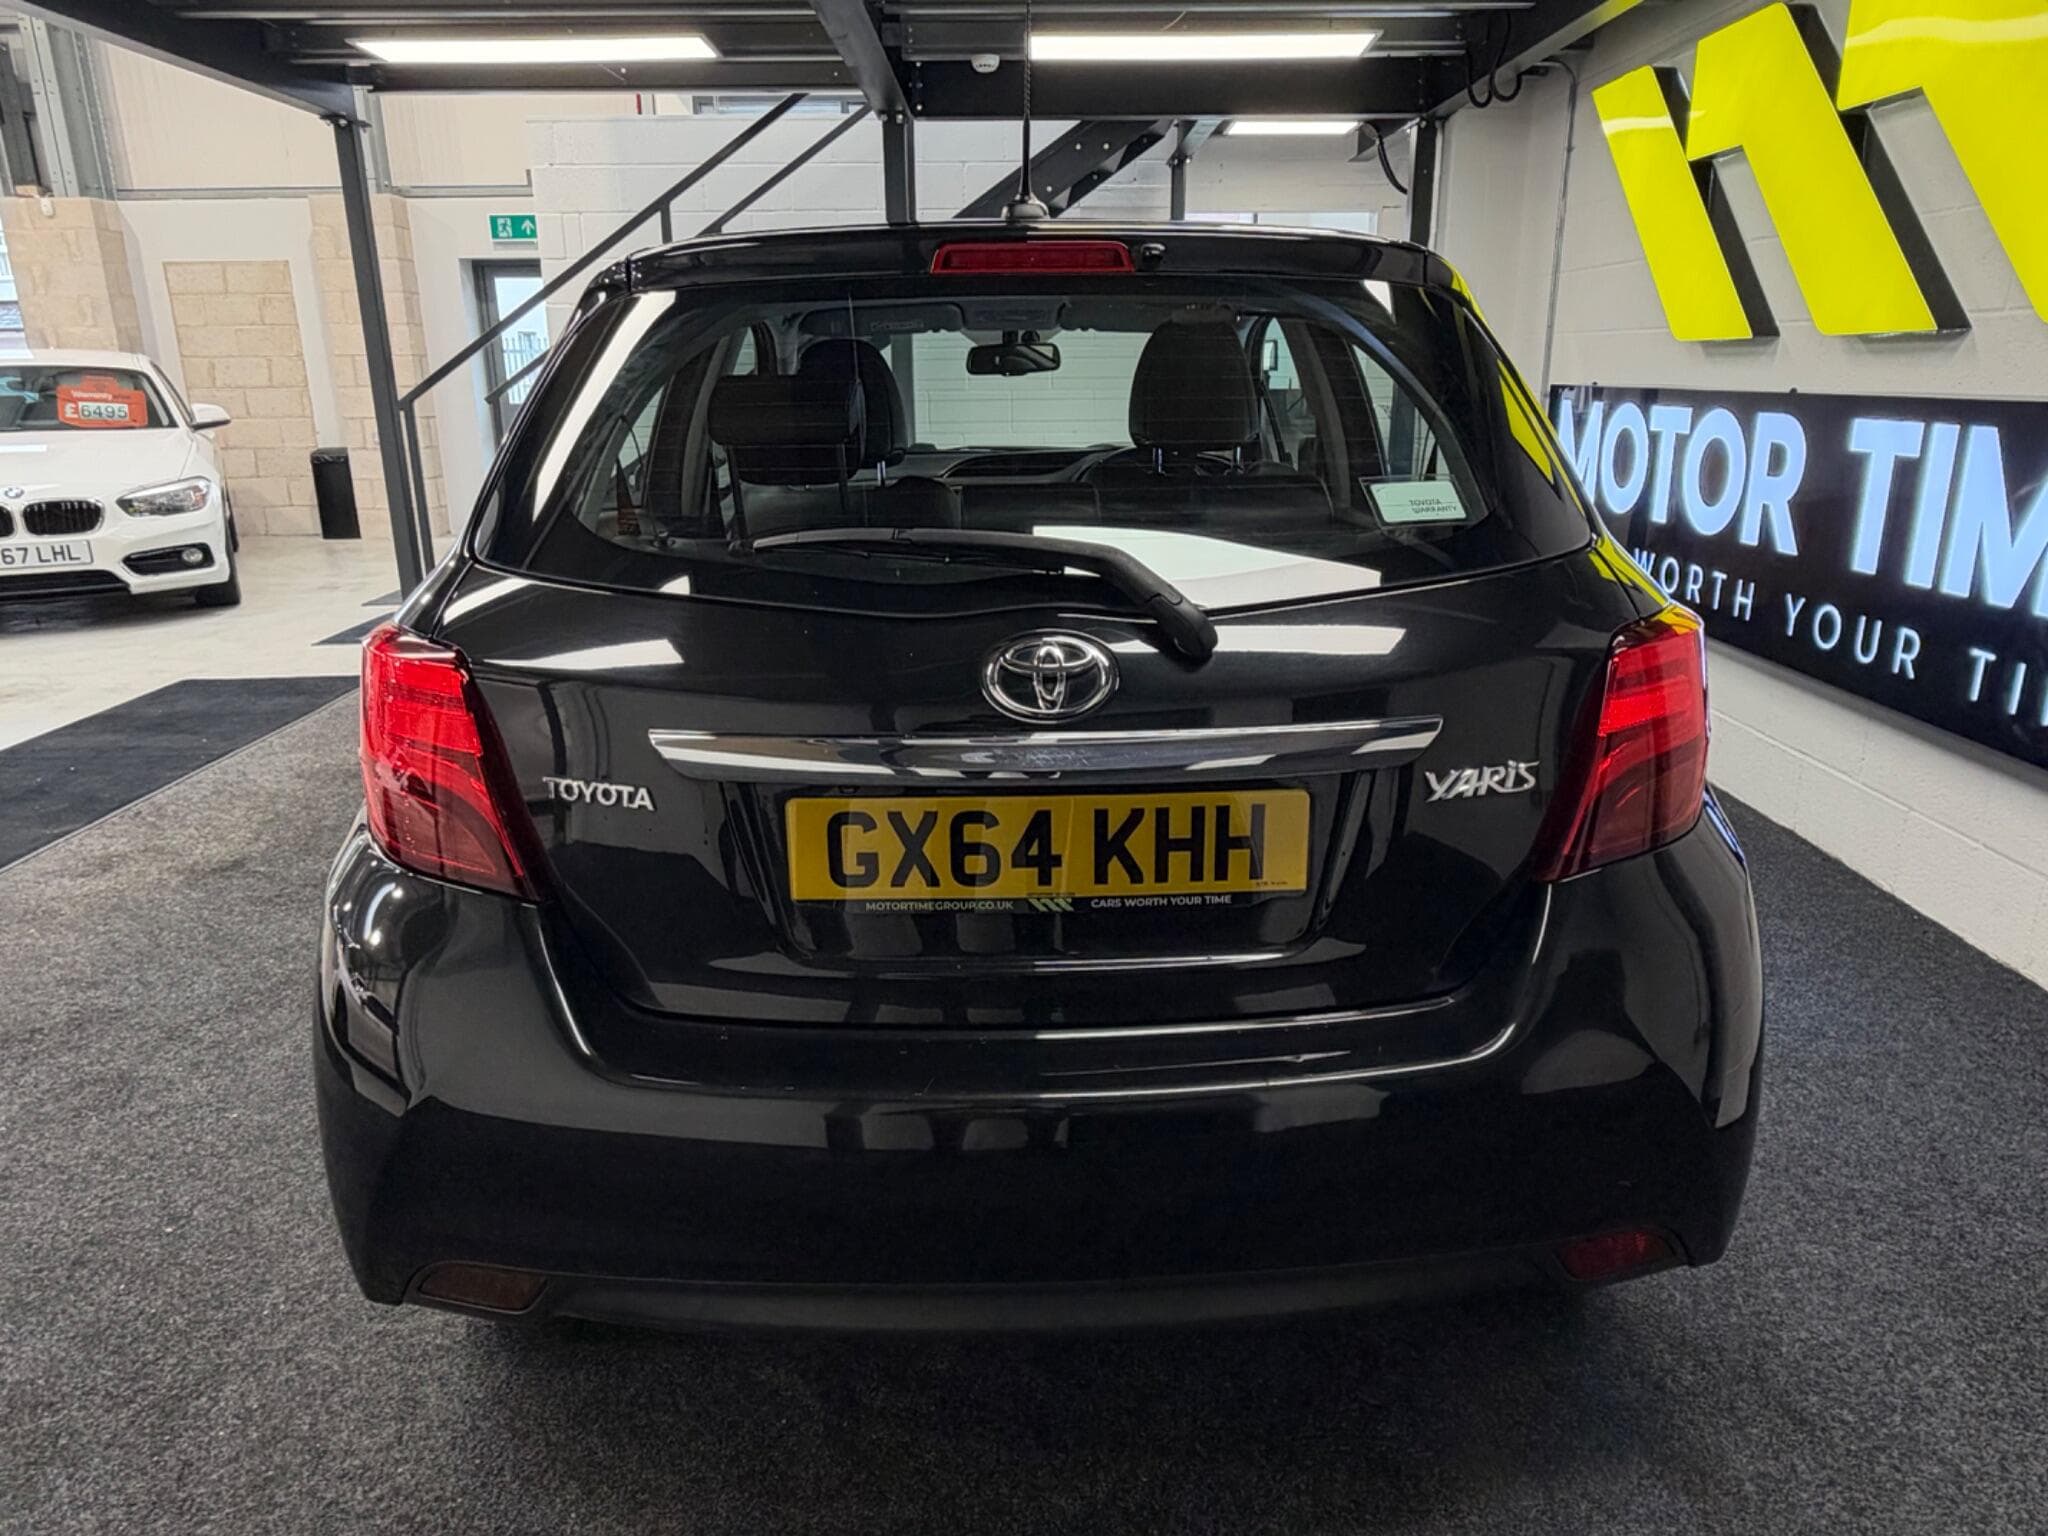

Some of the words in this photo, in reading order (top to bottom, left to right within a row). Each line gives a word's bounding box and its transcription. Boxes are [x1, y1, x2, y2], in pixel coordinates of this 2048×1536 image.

[64, 402, 129, 419] £6495
[1558, 399, 1806, 556] MOTOR
[36, 544, 81, 563] LHL
[1632, 547, 1756, 622] WORTH
[1785, 592, 1921, 680] YOUR
[1969, 647, 2048, 727] TI
[541, 776, 655, 811] TOYOTA
[826, 808, 1063, 889] GX64
[1093, 803, 1266, 885] KHH
[865, 900, 1014, 912] MOTORTIMEGROUP.CO.UK
[1090, 898, 1122, 908] CARS
[1124, 897, 1168, 907] WORTH
[1170, 896, 1201, 906] YOUR
[1205, 894, 1232, 905] TIME
